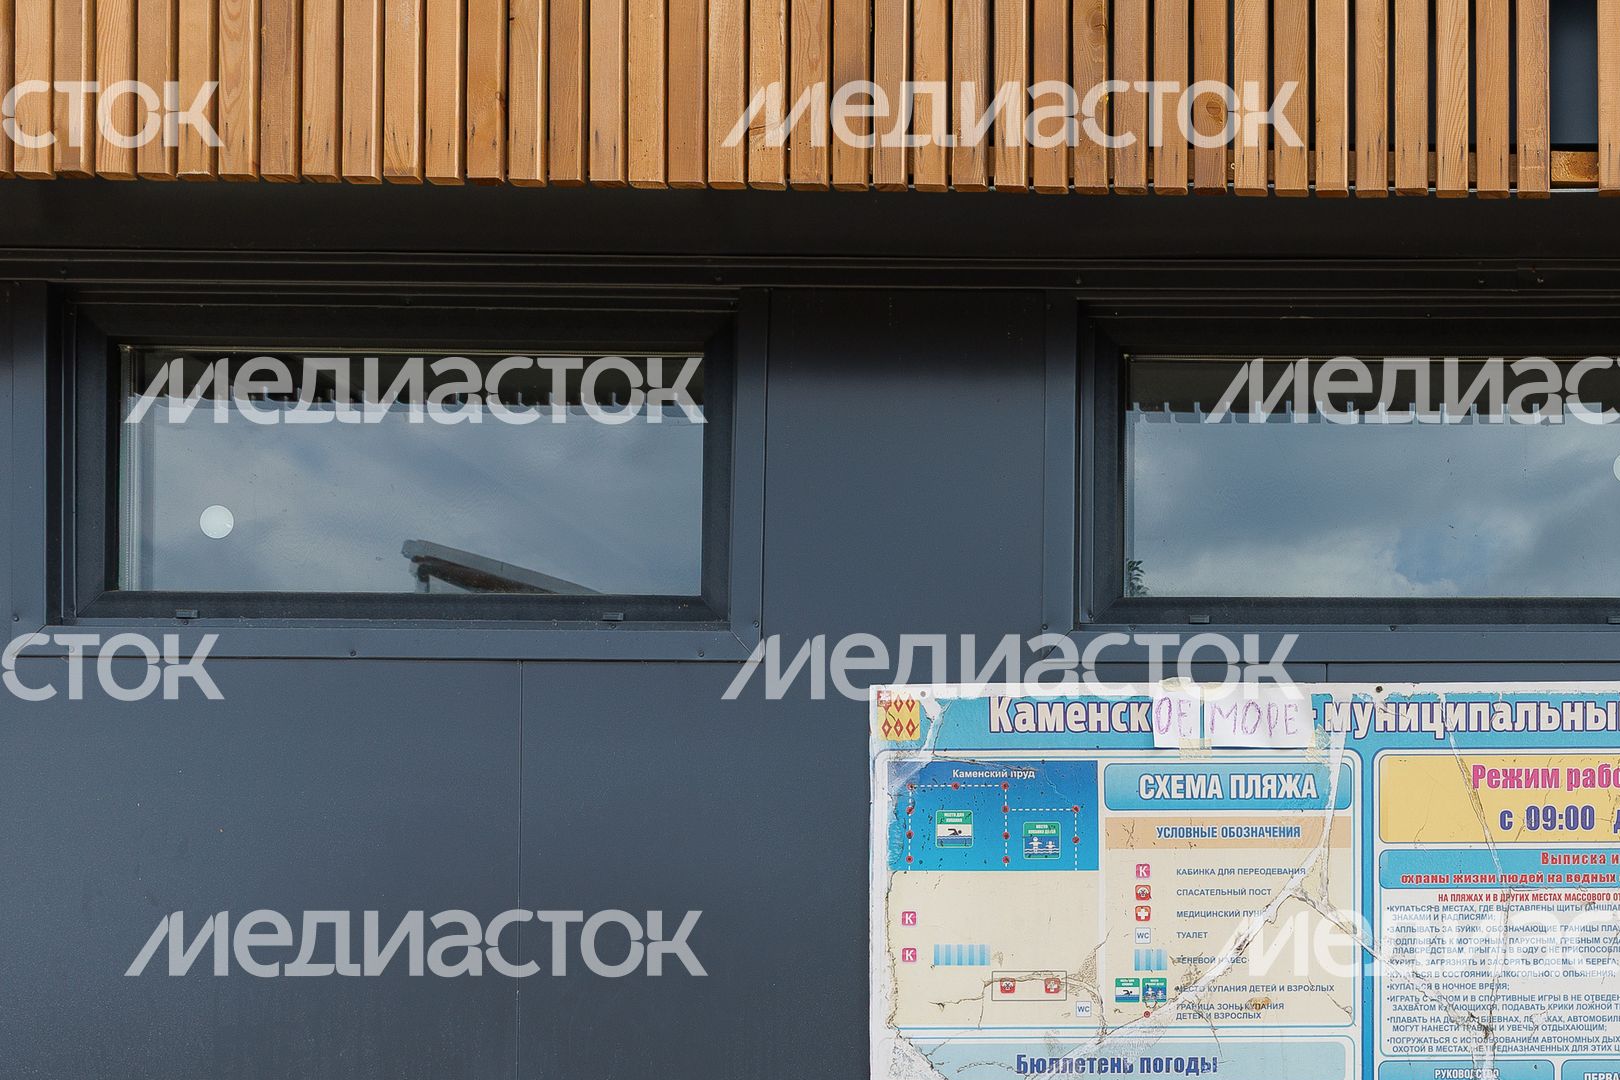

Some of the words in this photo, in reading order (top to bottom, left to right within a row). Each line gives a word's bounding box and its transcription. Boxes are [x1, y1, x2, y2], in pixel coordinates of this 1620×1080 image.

[952, 768, 1008, 779] Каменский
[1010, 769, 1036, 780] пруд
[1472, 763, 1561, 790] Режим
[1138, 773, 1225, 800] СХЕМА
[1229, 773, 1319, 800] ПЛЯЖА
[1500, 810, 1514, 831] с
[1525, 803, 1596, 832] 09:00
[1156, 826, 1218, 839] УСЛОВНЫЕ
[1221, 826, 1301, 839] ОБОЗНАЧЕНИЯ
[1541, 851, 1606, 866] Выписка
[1176, 868, 1216, 876] КАБИНКА
[1217, 868, 1235, 877] ДЛЯ
[1237, 867, 1306, 877] ПЕРЕОДЕВАНИЯ
[1401, 875, 1450, 885] охраны
[1453, 874, 1497, 884] жизни
[1500, 871, 1544, 885] людей
[1547, 874, 1563, 883] на
[1566, 873, 1616, 884] водных
[1176, 887, 1247, 896] СПАСАТЕЛЬНЫЙ
[1248, 888, 1272, 896] ПОСТ
[1438, 894, 1448, 902] НА
[1450, 894, 1484, 902] ПЛЯЖАХ
[1500, 894, 1530, 903] ДРУГИХ
[1532, 893, 1562, 902] МЕСТАХ
[1564, 893, 1610, 902] МАССОВОГО
[1176, 909, 1241, 919] МЕДИЦИНСКИЙ
[1176, 931, 1208, 939] ТУАЛЕТ
[1207, 984, 1247, 992] КУПАНИЯ
[1249, 983, 1277, 993] ДЕТЕЙ
[1286, 983, 1335, 992] ВЗРОСЛЫХ
[1501, 1003, 1546, 1012] ПОДАВАТЬ
[1576, 1002, 1612, 1011] ЛОЖНОЙ
[1214, 1011, 1262, 1020] ВЗРОСЛЫХ
[1541, 1036, 1600, 1044] АВТОНОМНЫХ
[1016, 1053, 1134, 1075] Бюллетень
[1139, 1056, 1218, 1077] погоды
